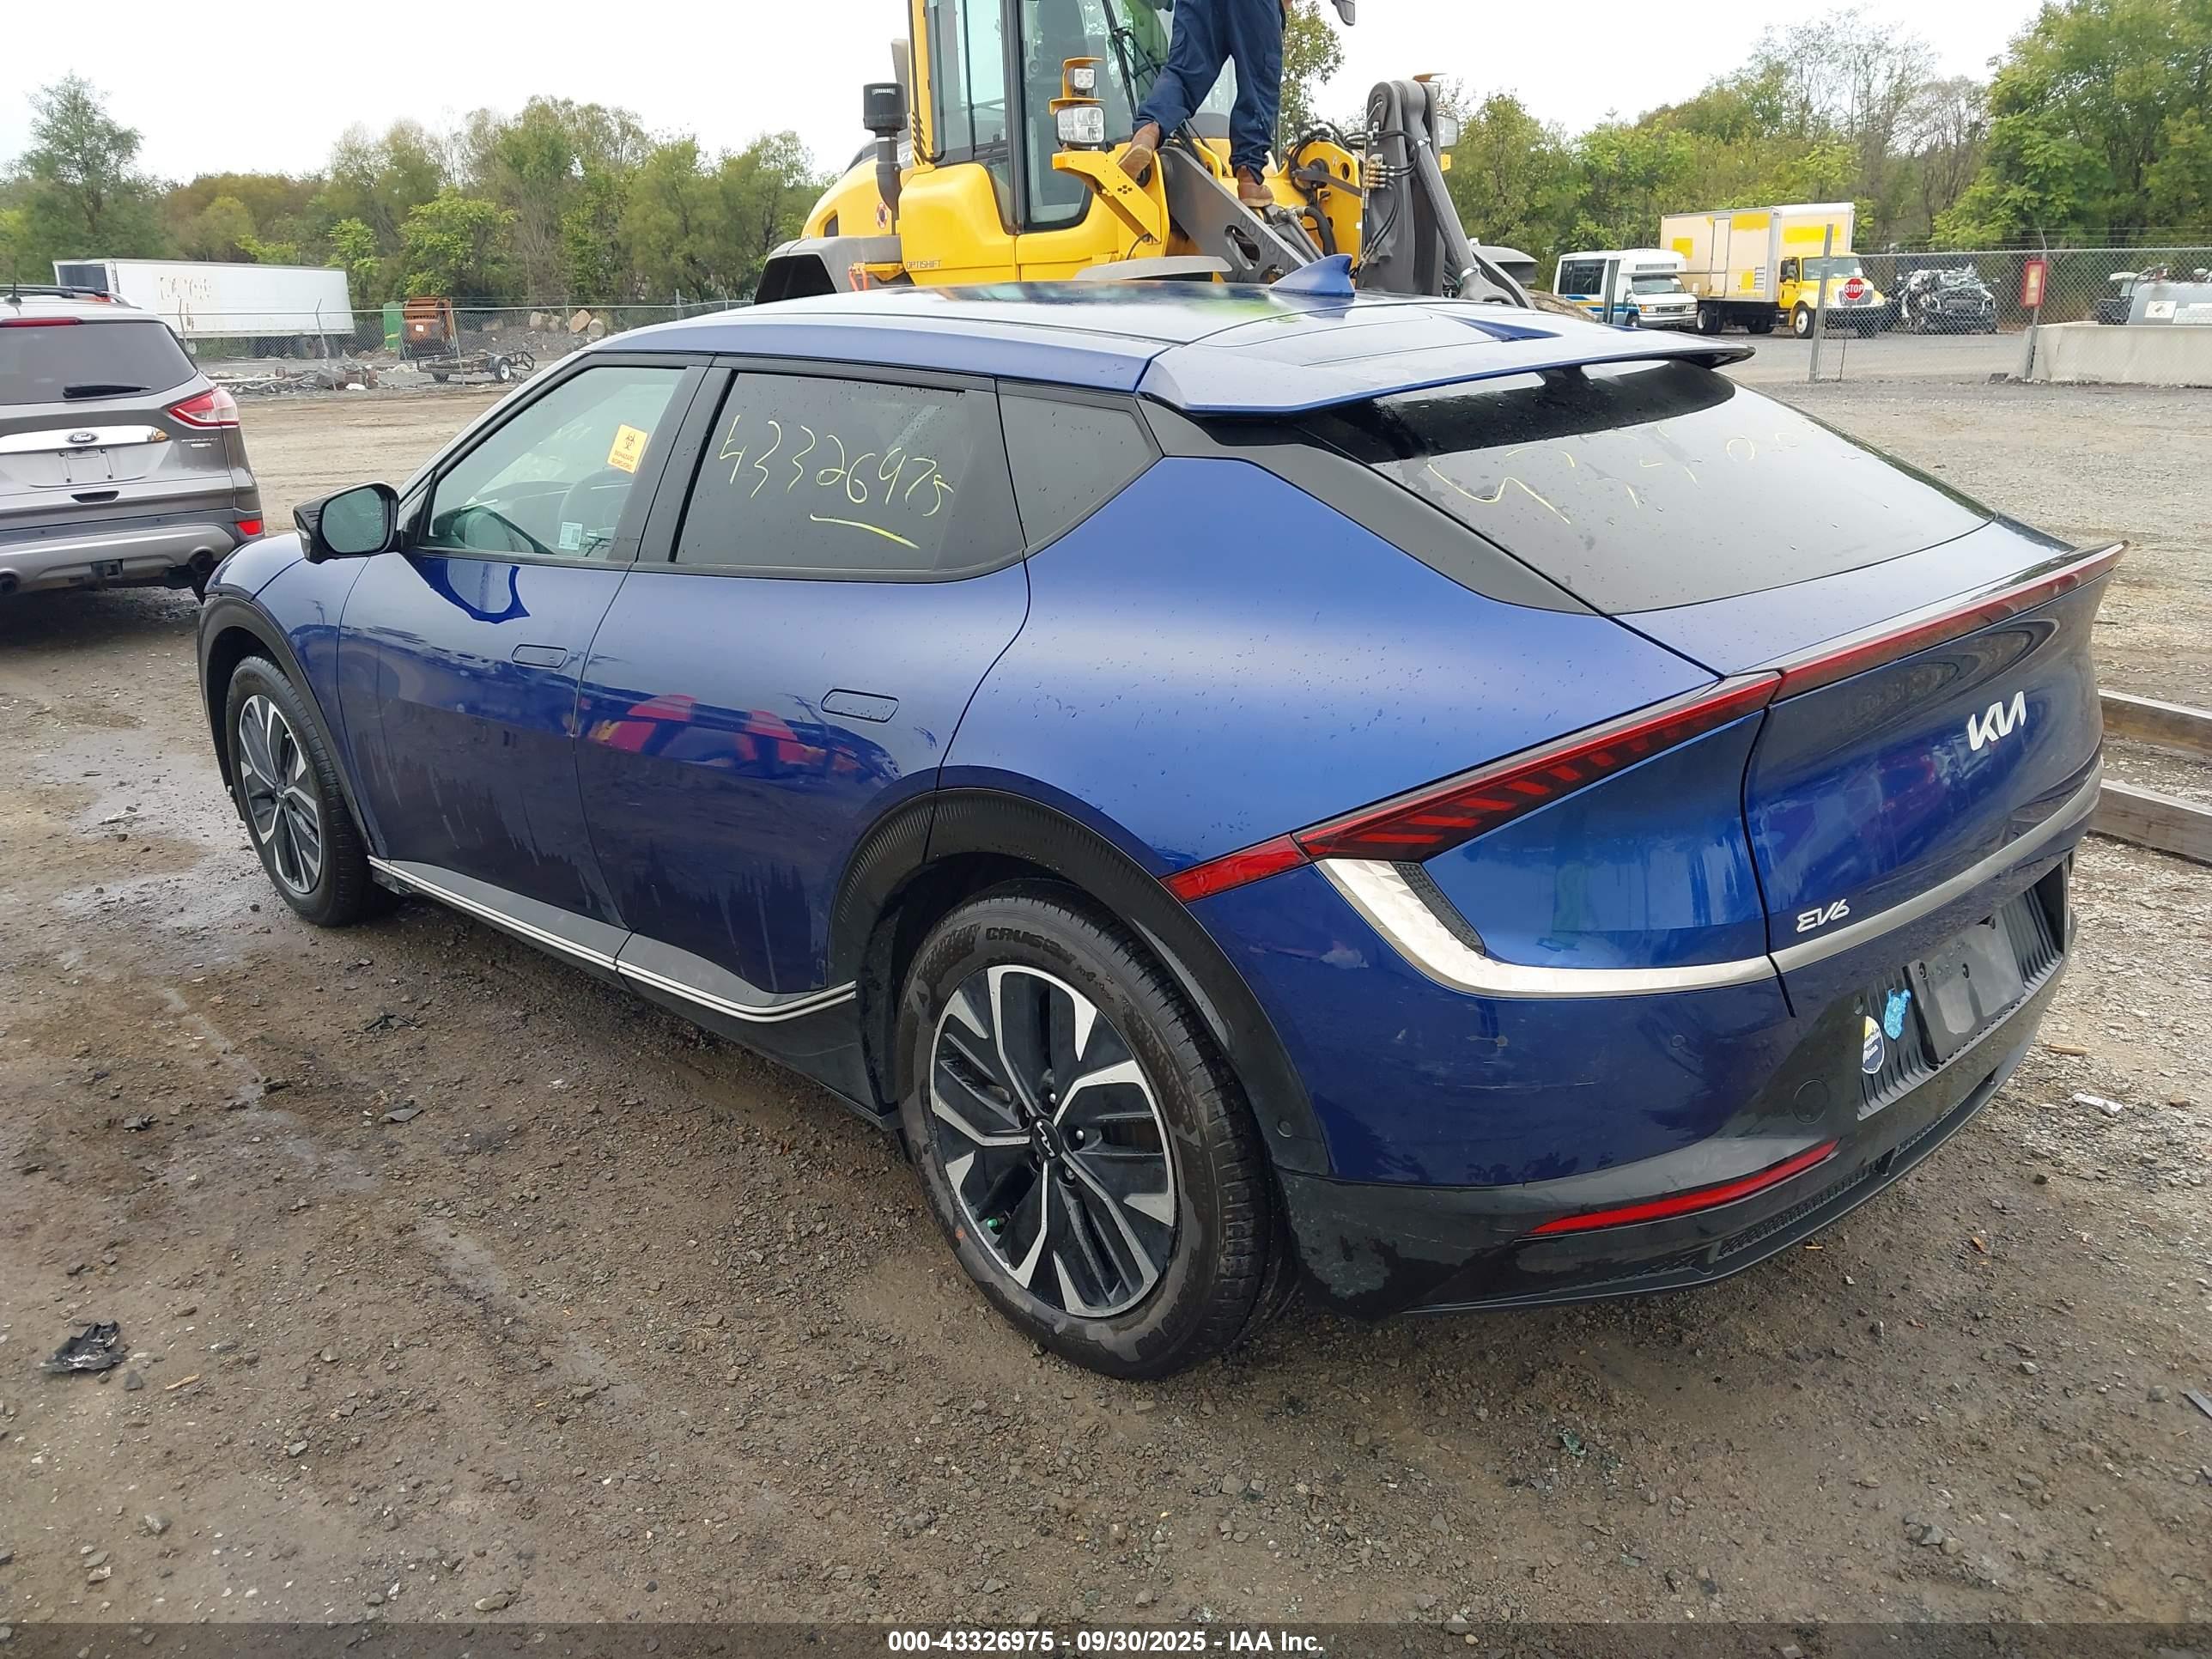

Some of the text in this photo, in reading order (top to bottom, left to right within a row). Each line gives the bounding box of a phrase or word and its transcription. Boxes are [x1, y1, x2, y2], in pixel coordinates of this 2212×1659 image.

[906, 260, 942, 270] OPTISHIFT
[1844, 283, 1864, 294] STOP
[720, 415, 955, 517] 43326975
[1796, 898, 1850, 933] EV6
